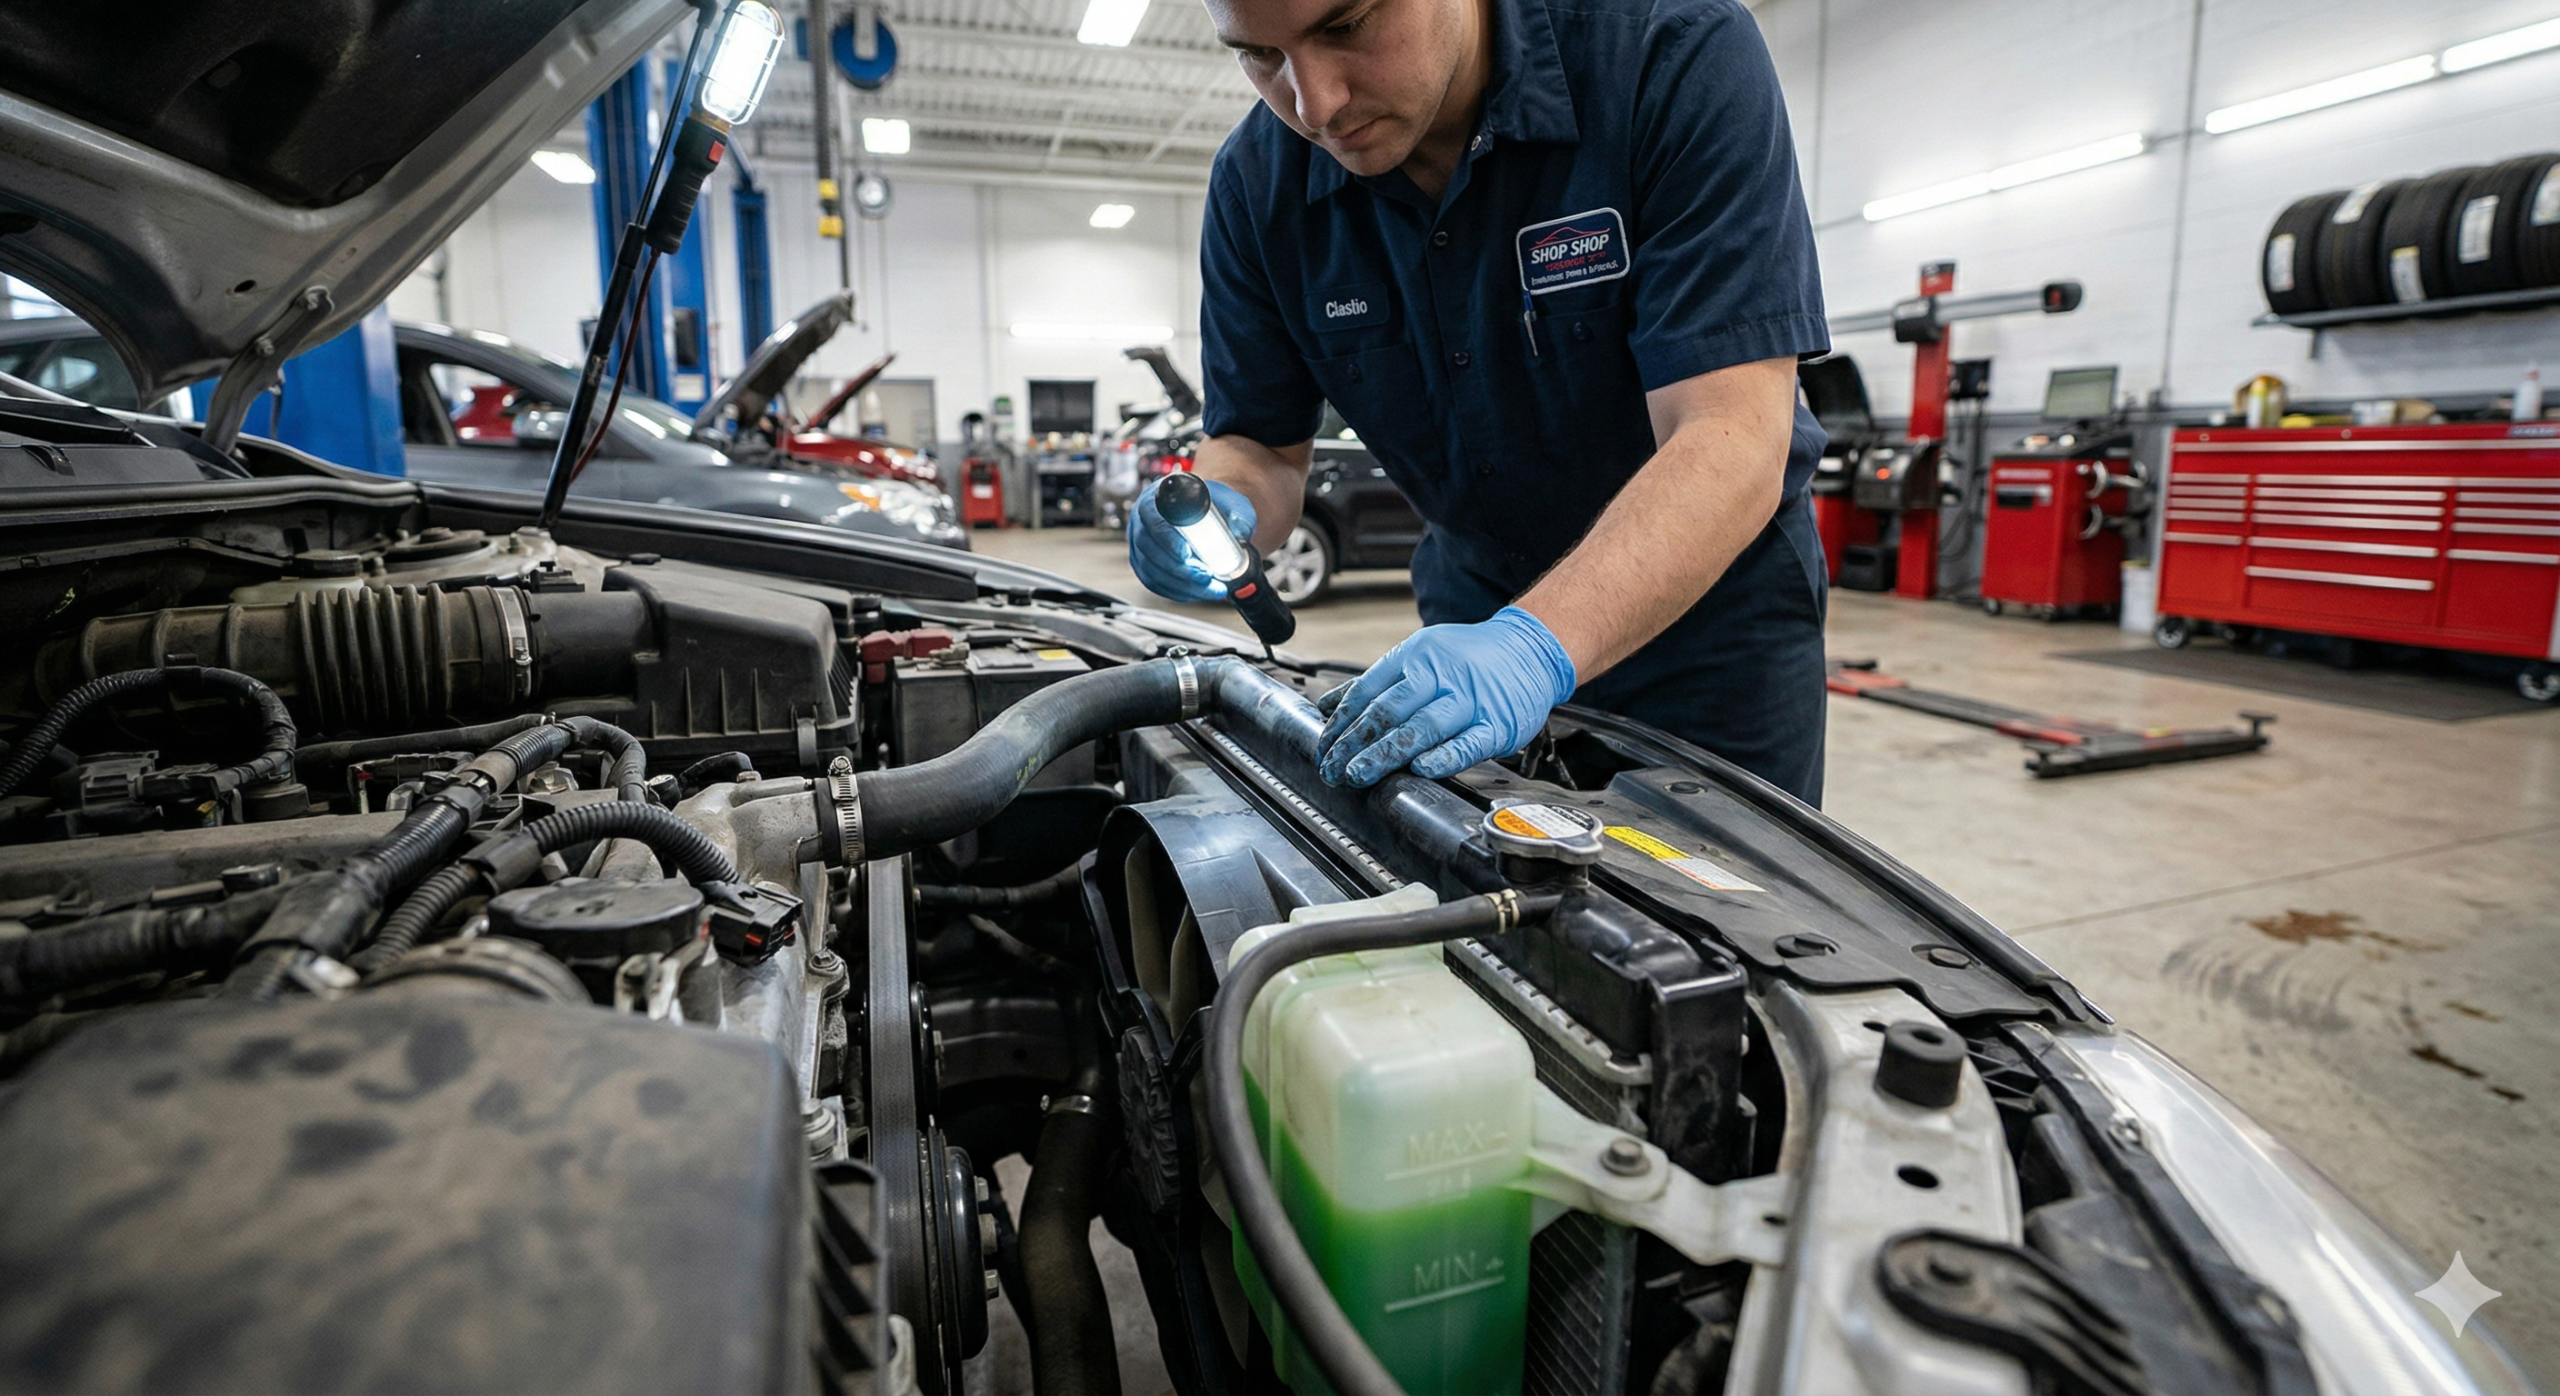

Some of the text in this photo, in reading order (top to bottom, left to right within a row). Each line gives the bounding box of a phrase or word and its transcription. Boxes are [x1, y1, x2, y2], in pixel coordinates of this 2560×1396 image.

[1531, 244, 1568, 264] SHOP
[1570, 234, 1609, 256] SHOP
[1326, 298, 1368, 318] Clastio
[1408, 1120, 1487, 1166] MAX
[1413, 1249, 1477, 1294] MIN
